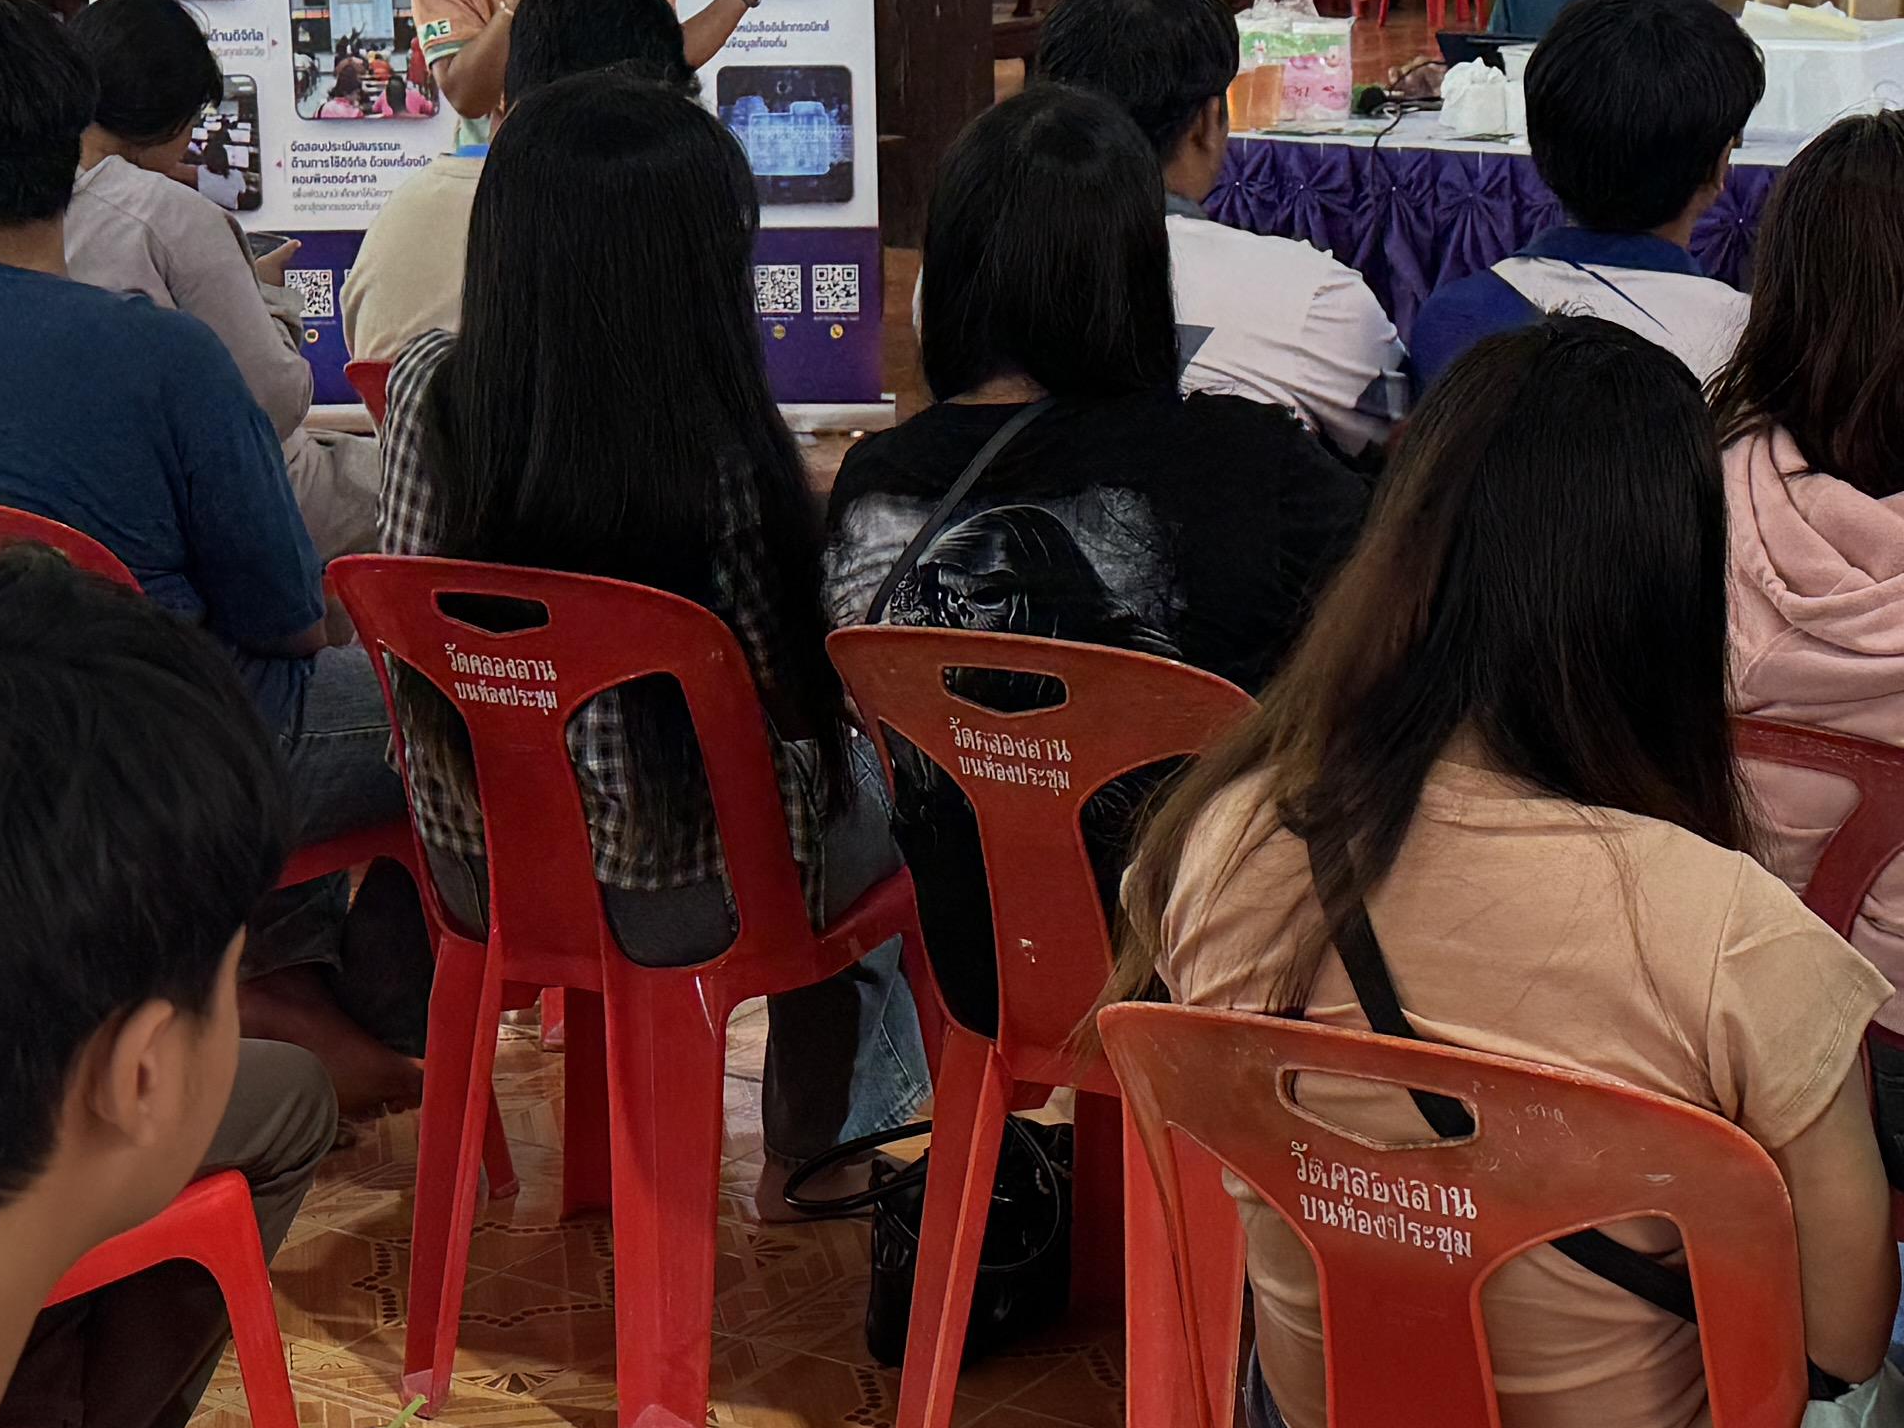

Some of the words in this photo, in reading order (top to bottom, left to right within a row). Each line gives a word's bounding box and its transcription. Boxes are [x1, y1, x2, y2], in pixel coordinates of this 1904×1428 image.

[444, 644, 558, 681] วัดคลองลาน
[1291, 1140, 1477, 1220] วัดคลองลาน
[1300, 1191, 1472, 1264] บนห้องประชุม
